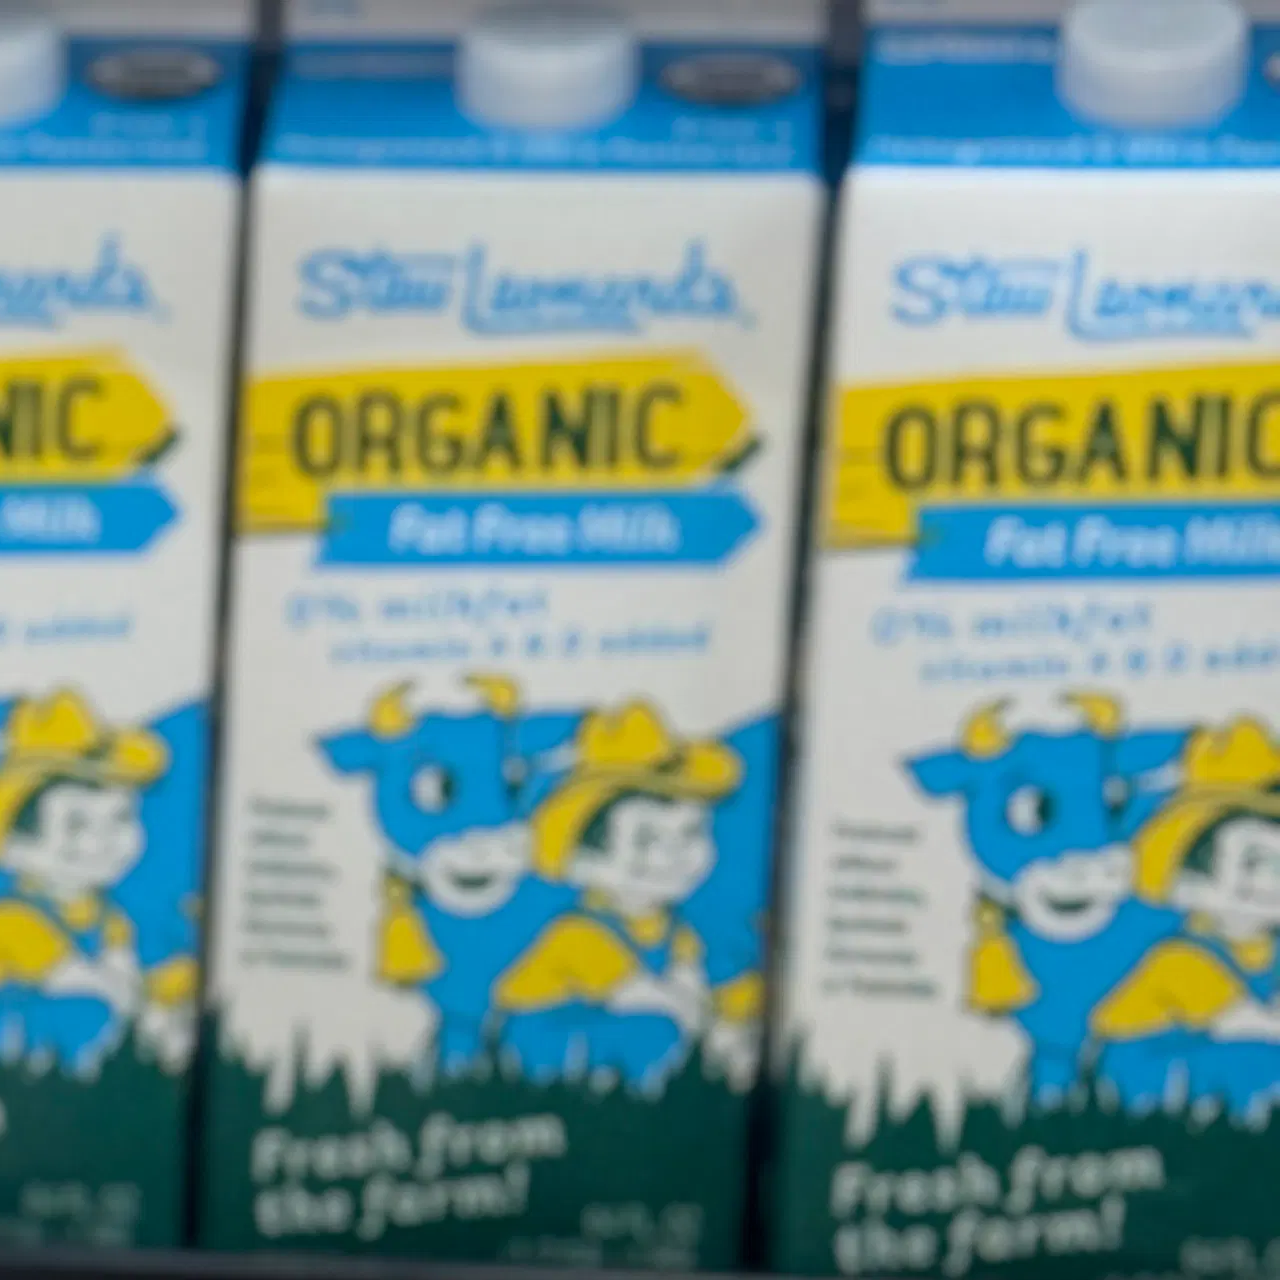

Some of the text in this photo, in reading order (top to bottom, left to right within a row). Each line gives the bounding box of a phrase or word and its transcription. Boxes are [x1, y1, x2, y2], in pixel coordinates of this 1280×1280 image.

[289, 381, 687, 480] ORGANIC
[416, 1110, 568, 1181] from
[831, 1144, 1166, 1220] Fresh from
